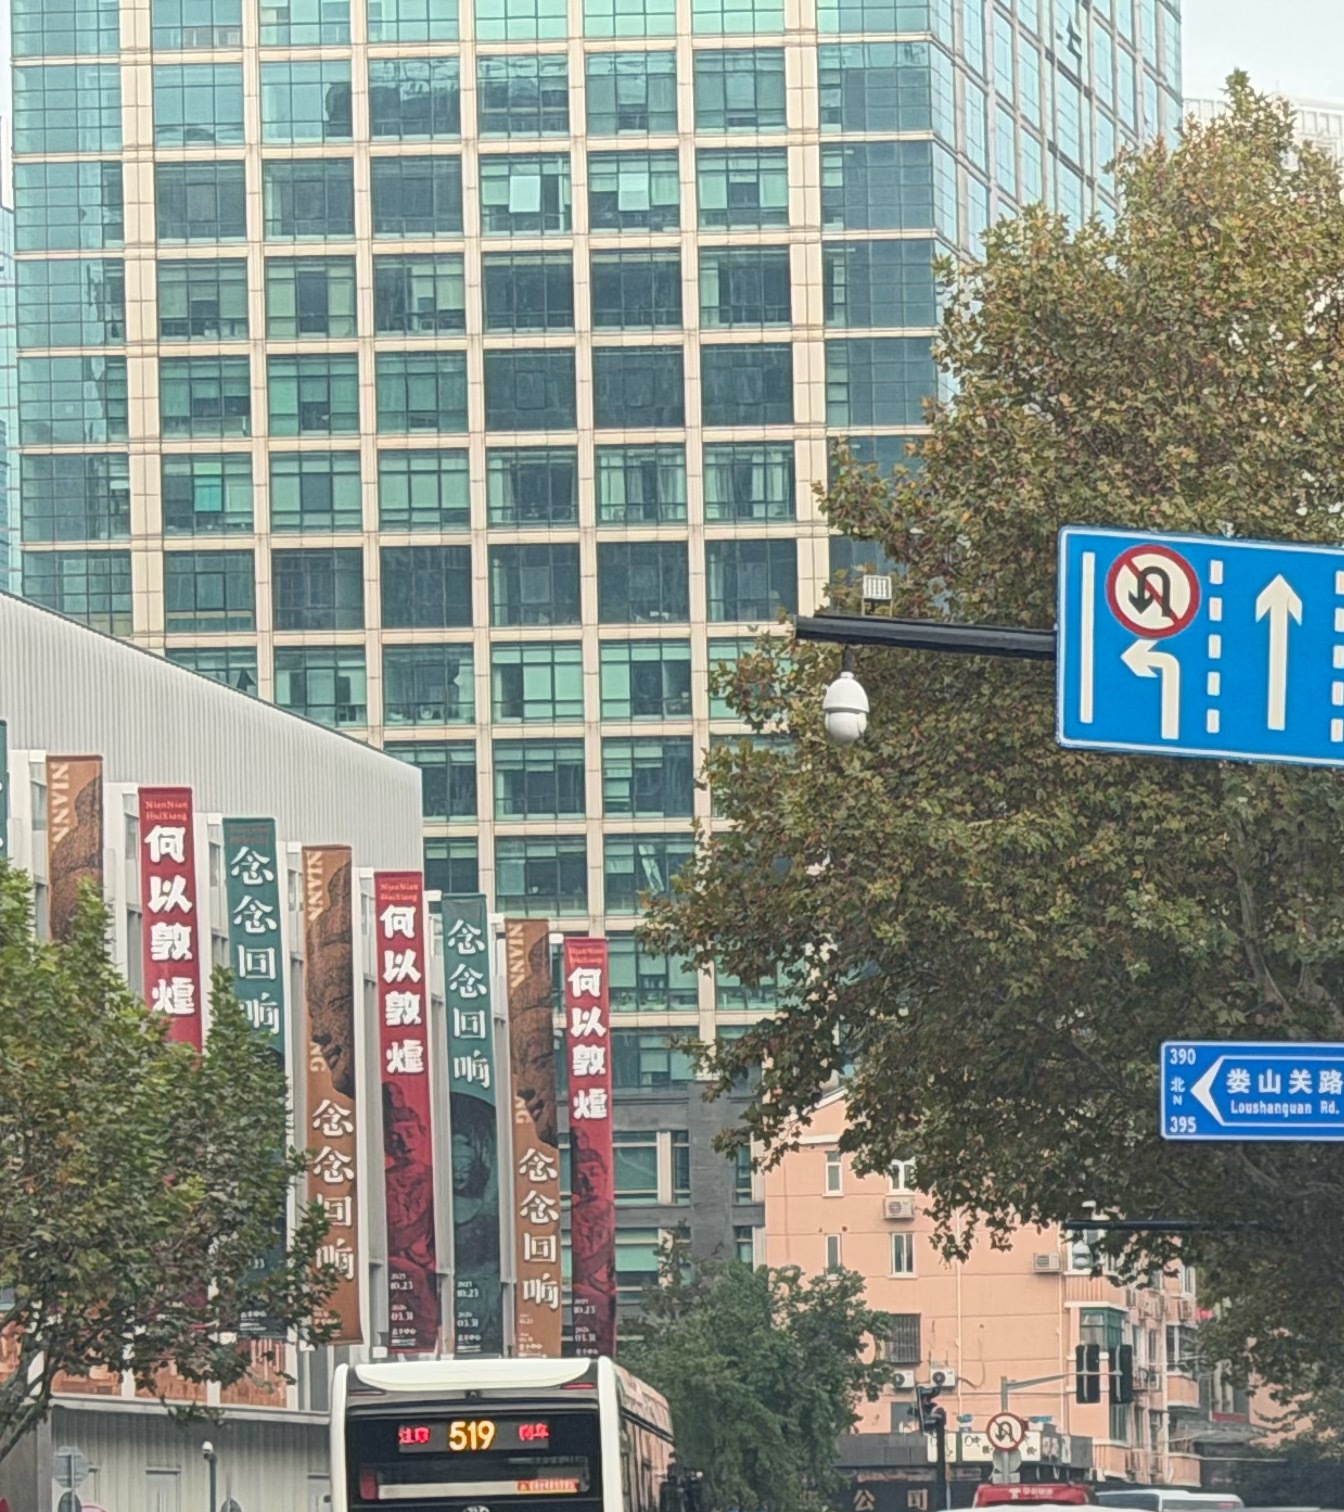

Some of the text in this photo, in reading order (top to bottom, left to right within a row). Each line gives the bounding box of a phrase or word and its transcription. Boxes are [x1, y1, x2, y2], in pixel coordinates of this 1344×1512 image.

[144, 825, 195, 1015] 何以敦煌
[231, 846, 280, 1035] 念念回响
[380, 904, 424, 1074] 何以敦煌
[447, 919, 491, 1088] 念念回响
[568, 967, 607, 1119] 何以敦煌
[1169, 1048, 1196, 1065] 390
[1170, 1077, 1185, 1092] 北
[1226, 1068, 1344, 1095] 娄山关路
[1173, 1095, 1182, 1106] N
[1231, 1100, 1340, 1118] Loushanguan Rd.
[1169, 1116, 1197, 1133] 395
[519, 1148, 560, 1310] 念念回响
[449, 1420, 495, 1451] 519
